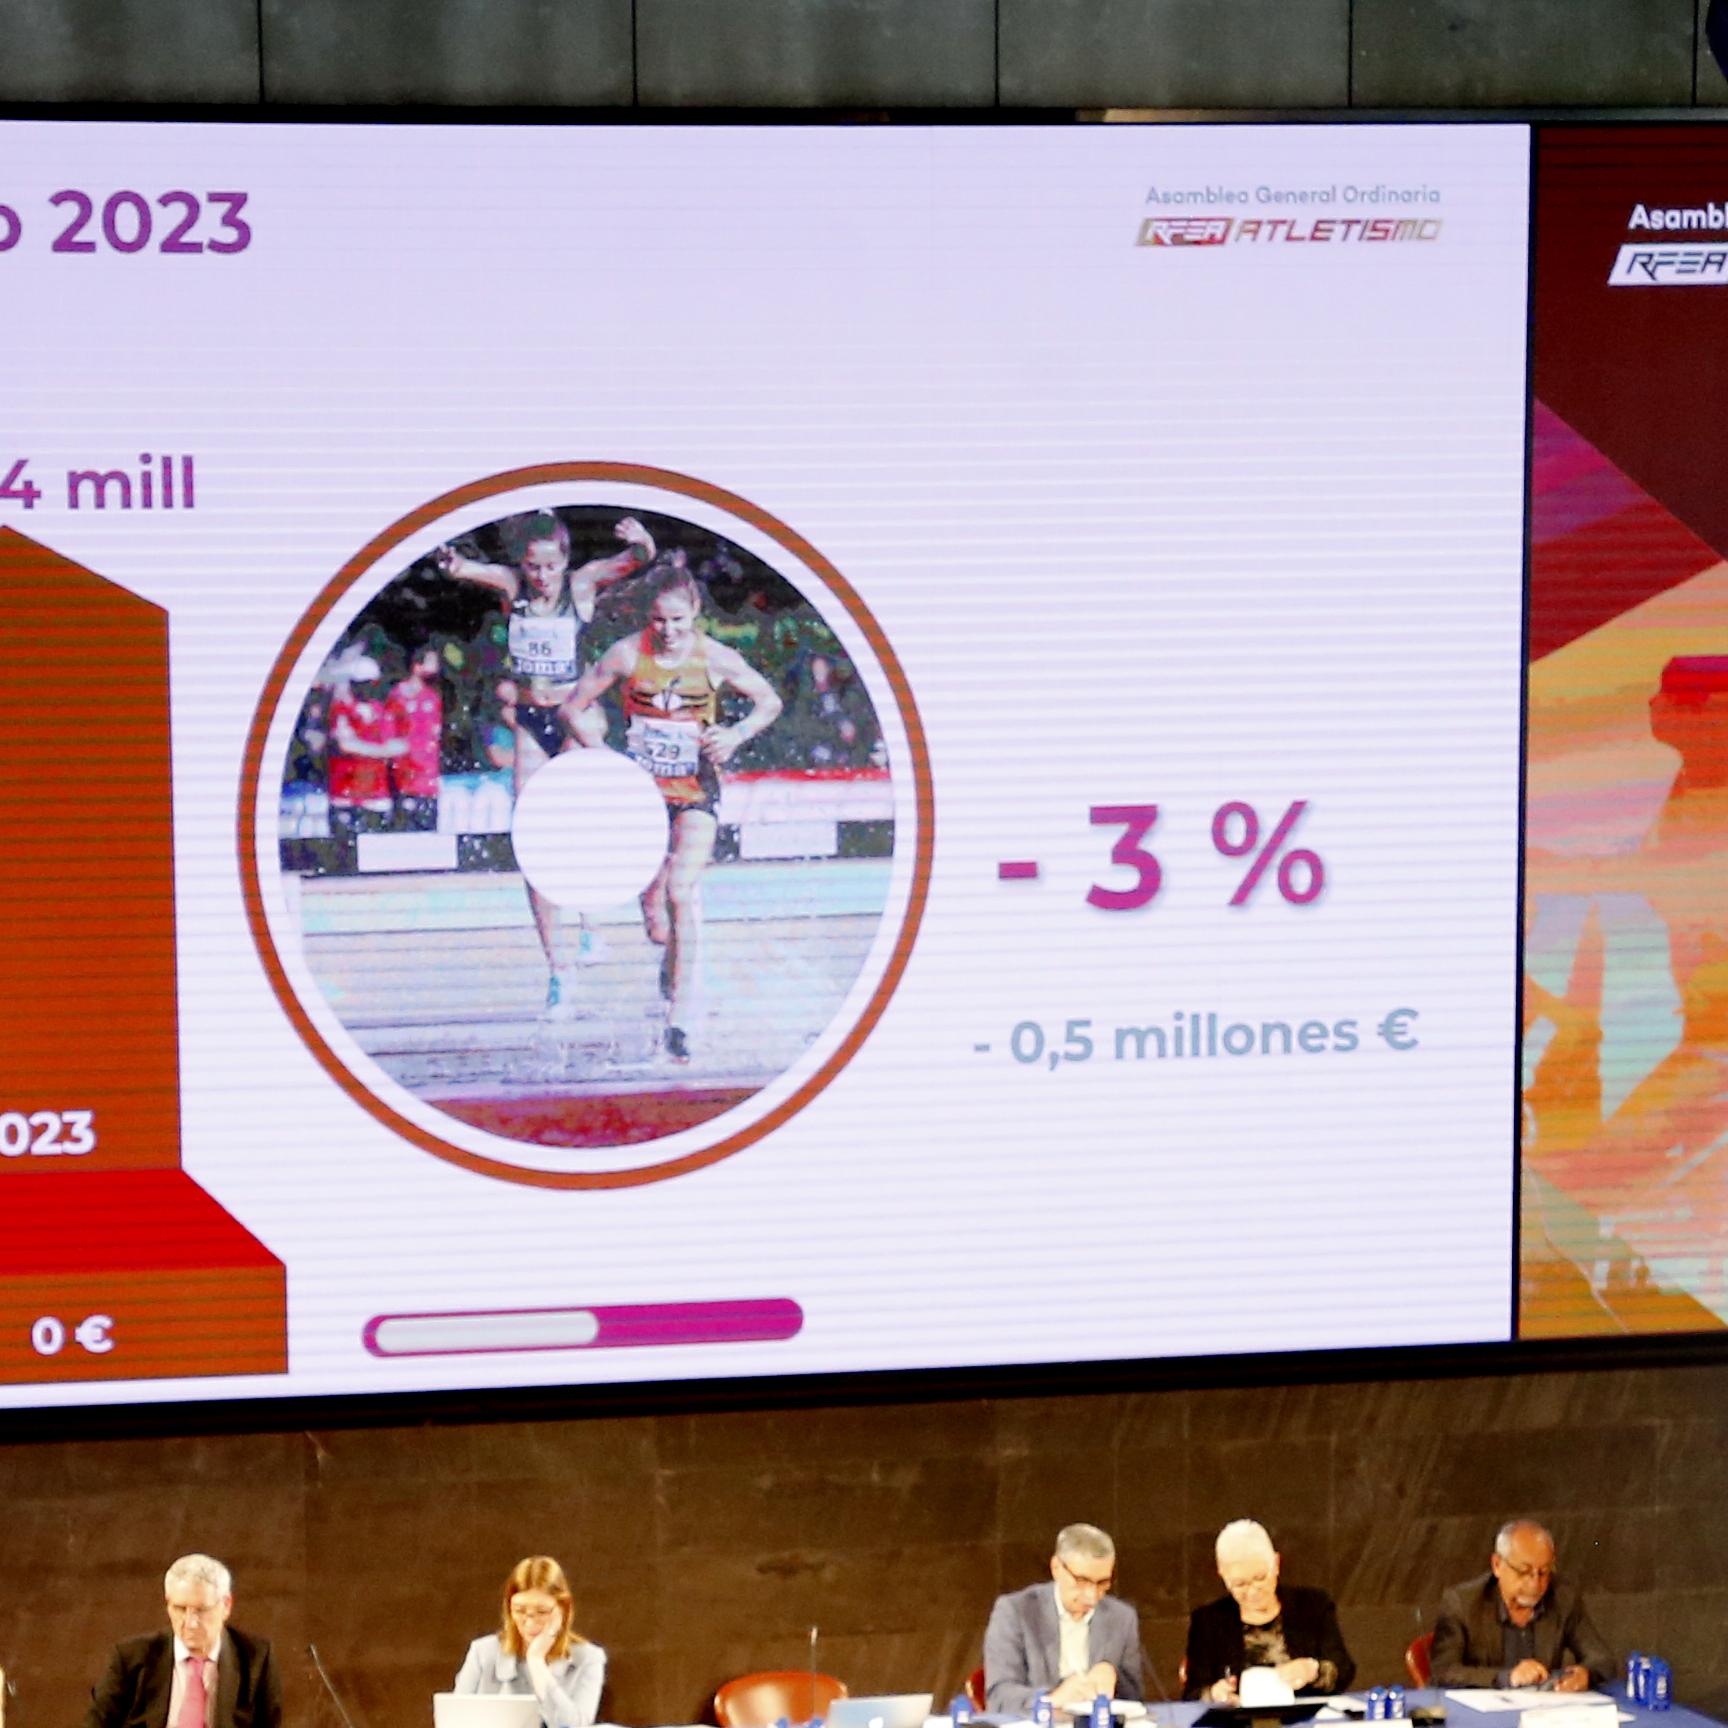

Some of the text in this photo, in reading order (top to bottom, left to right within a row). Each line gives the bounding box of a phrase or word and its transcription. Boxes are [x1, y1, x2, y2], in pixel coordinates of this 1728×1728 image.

[48, 189, 253, 255] 2023
[1144, 184, 1441, 205] Asamblea General Ordinaria
[1233, 218, 1444, 243] ATLETISMO
[66, 452, 195, 510] mill
[1085, 803, 1163, 912] 3
[1211, 799, 1327, 907] %
[1010, 1018, 1094, 1072] 0,5
[1114, 1010, 1360, 1061] millones
[1376, 1007, 1420, 1052] €
[30, 1313, 116, 1356] 0 €
